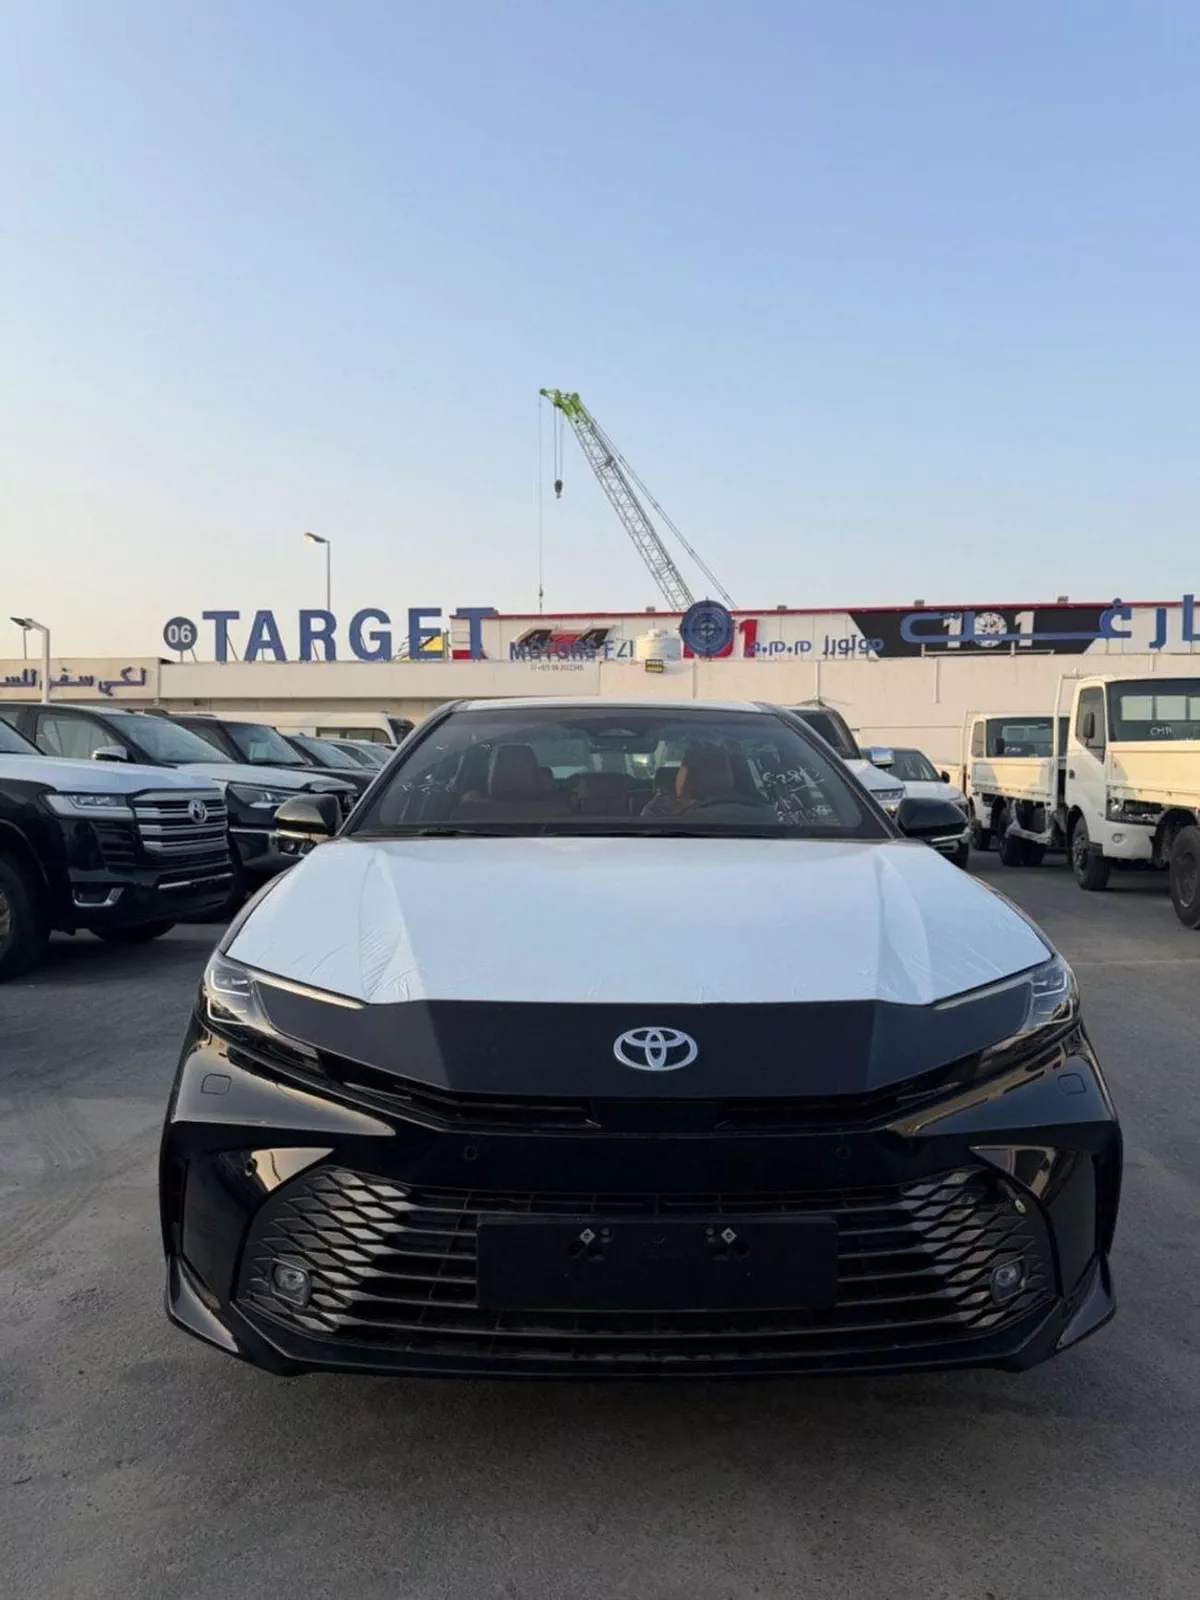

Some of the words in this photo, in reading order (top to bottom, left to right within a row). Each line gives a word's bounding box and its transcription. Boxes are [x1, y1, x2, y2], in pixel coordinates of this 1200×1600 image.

[167, 624, 192, 643] 06
[202, 607, 497, 661] TARGET
[509, 640, 596, 661] MOTORS
[603, 639, 635, 659] FZ
